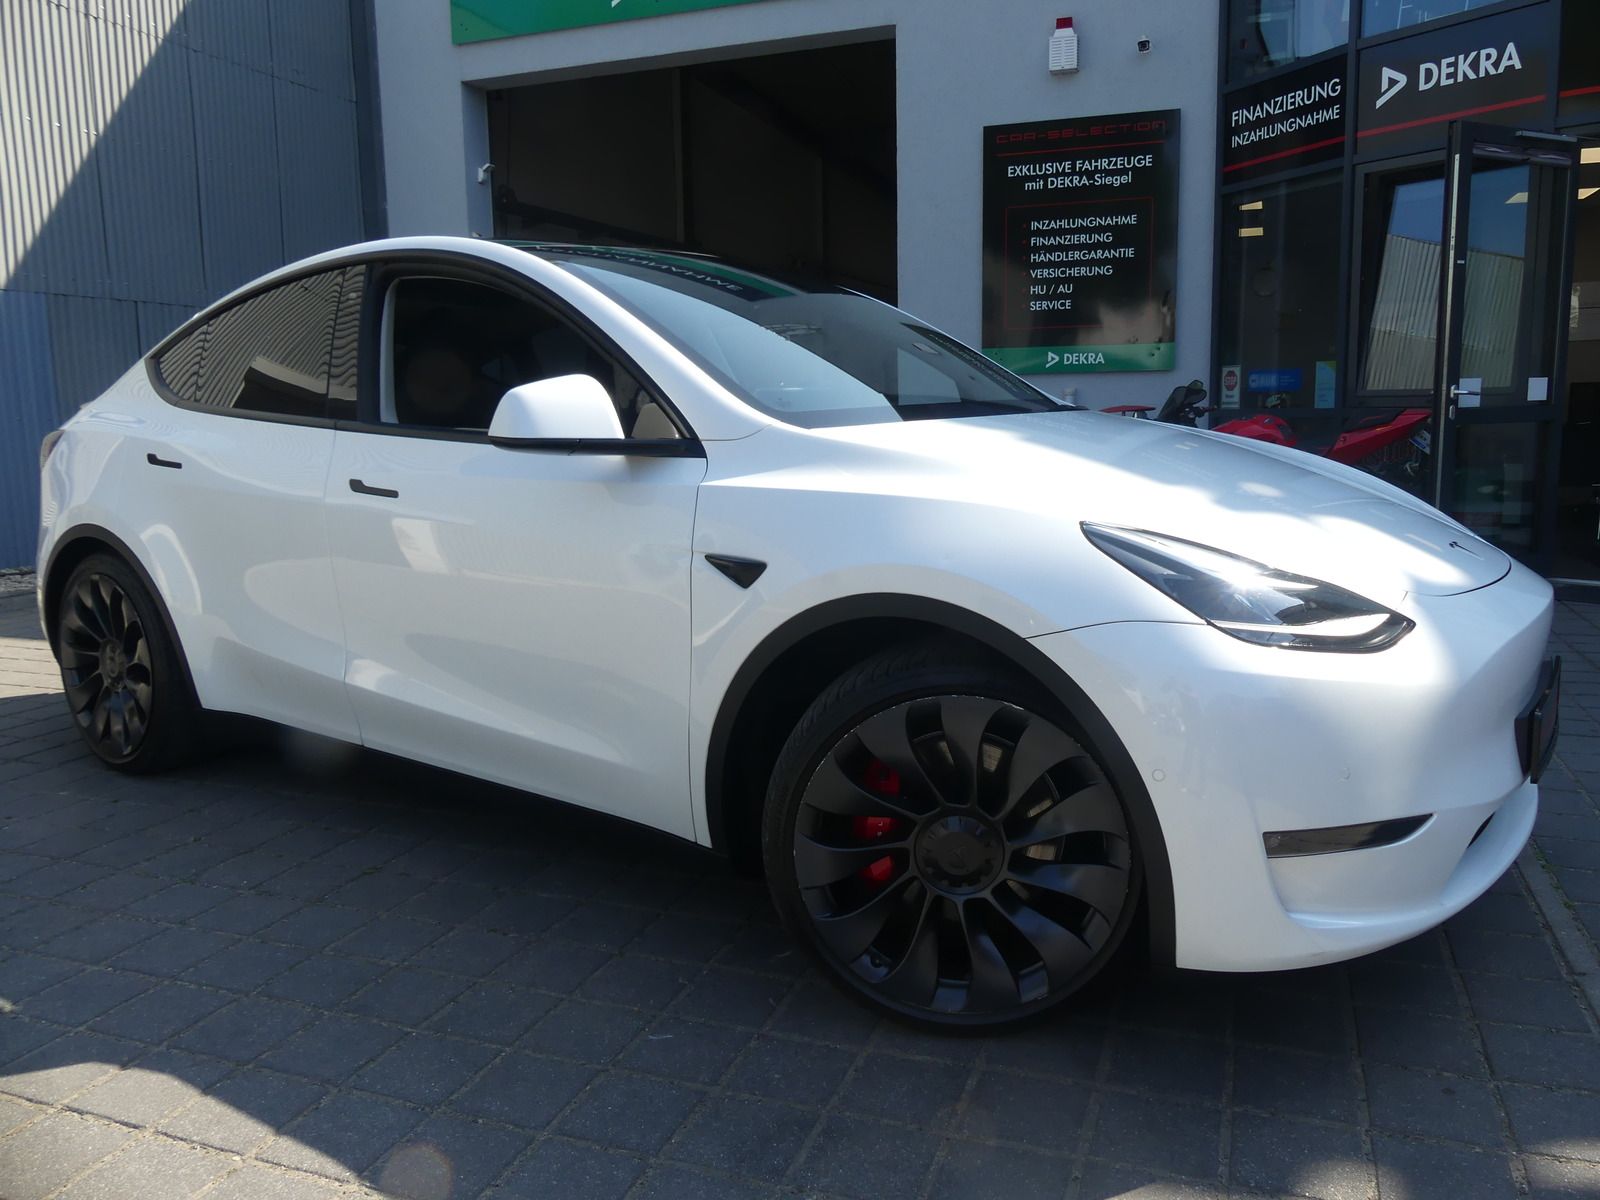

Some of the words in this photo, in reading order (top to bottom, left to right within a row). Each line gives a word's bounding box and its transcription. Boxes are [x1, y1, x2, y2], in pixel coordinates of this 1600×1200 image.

[1418, 42, 1522, 92] DEKRA
[1231, 78, 1341, 128] FINANZIERUNG
[996, 121, 1166, 143] CAR-SELECTION
[1231, 104, 1340, 149] INZAHLUNGNAHME
[1007, 161, 1072, 177] EXKLUSIVE
[1076, 155, 1153, 172] FAHRZEUGE
[1025, 179, 1044, 191] mit
[1047, 171, 1132, 189] DEKRA-Siegel
[1030, 214, 1138, 231] INZAHLUNGNAHME
[1030, 232, 1113, 247] FINANZIERUNG
[1030, 247, 1135, 263] HÄNDLERGARANTIE
[1030, 265, 1113, 279] VERSICHERUNG
[1030, 284, 1047, 295] HU
[1057, 283, 1073, 294] AU
[1030, 299, 1072, 311] SERVICE
[1063, 352, 1105, 365] DEKRA
